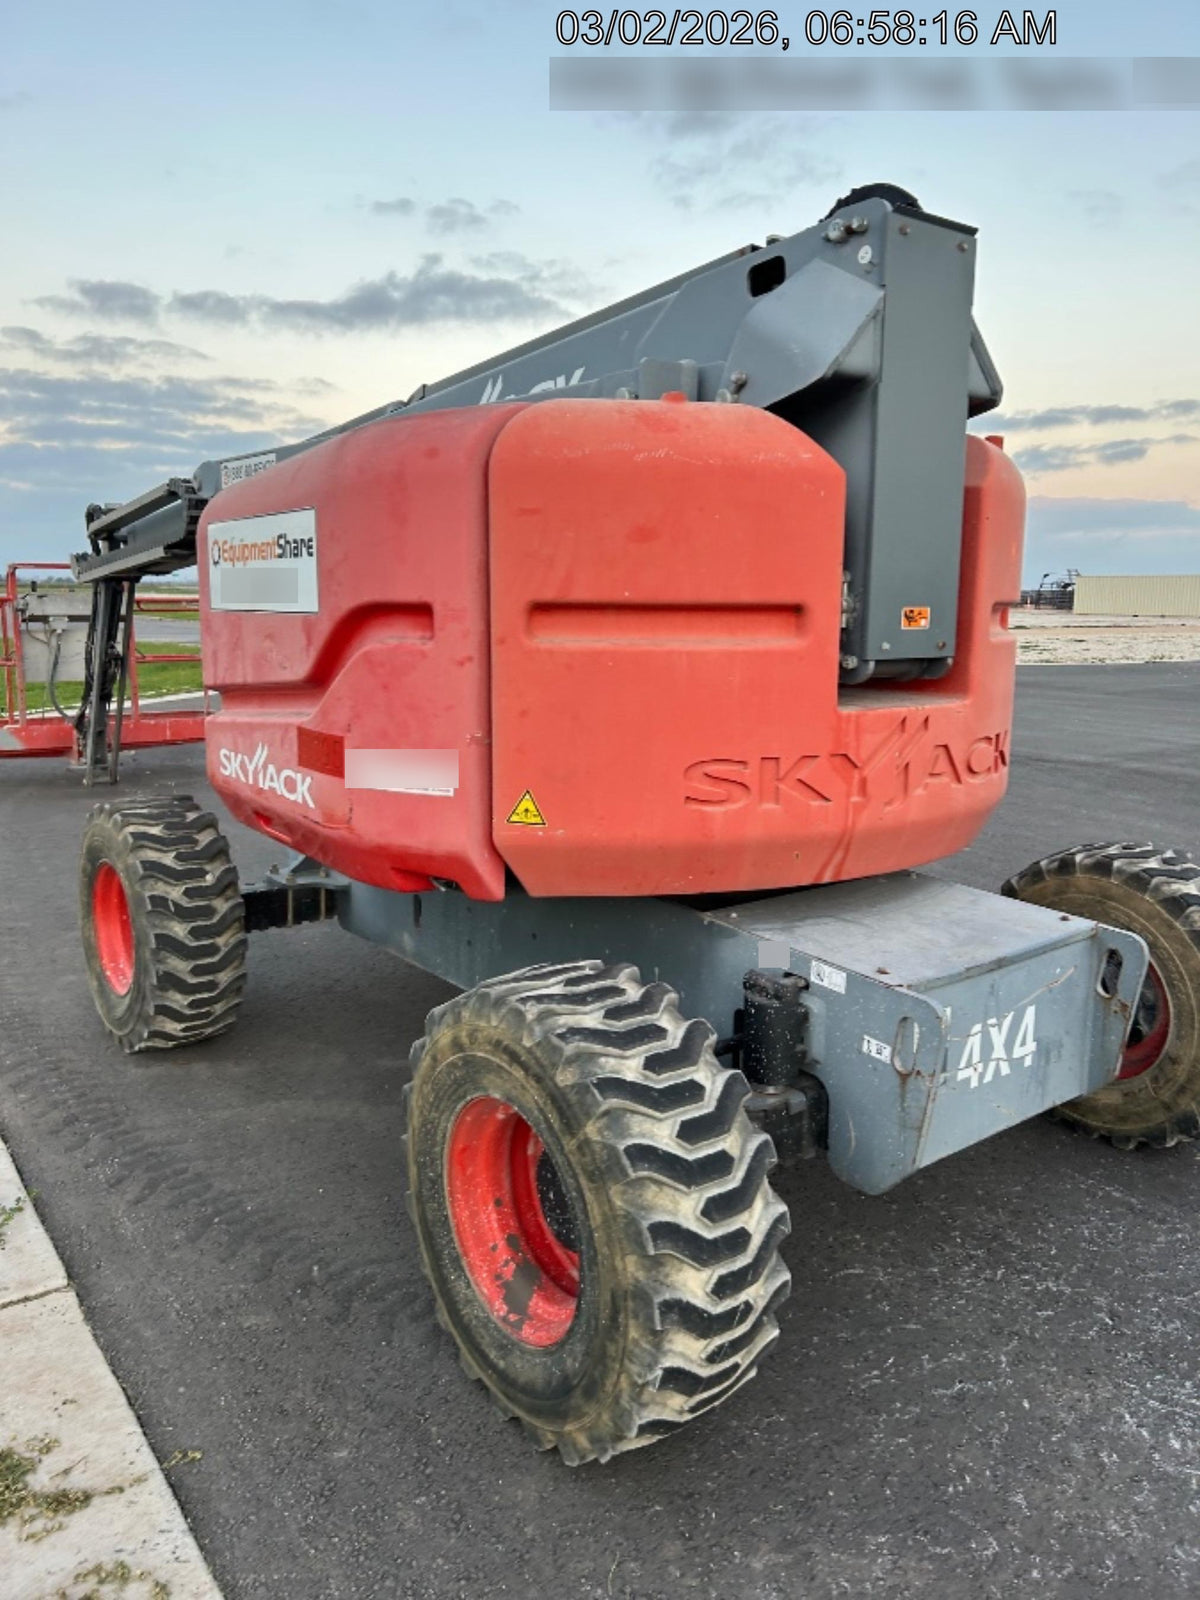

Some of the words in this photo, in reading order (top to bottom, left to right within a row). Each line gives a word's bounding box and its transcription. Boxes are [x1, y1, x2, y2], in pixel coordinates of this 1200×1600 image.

[221, 533, 314, 567] EquipmentShare
[219, 741, 315, 809] SKYJACK
[683, 714, 1009, 813] SKYJACK
[957, 1004, 1037, 1089] 4X4
